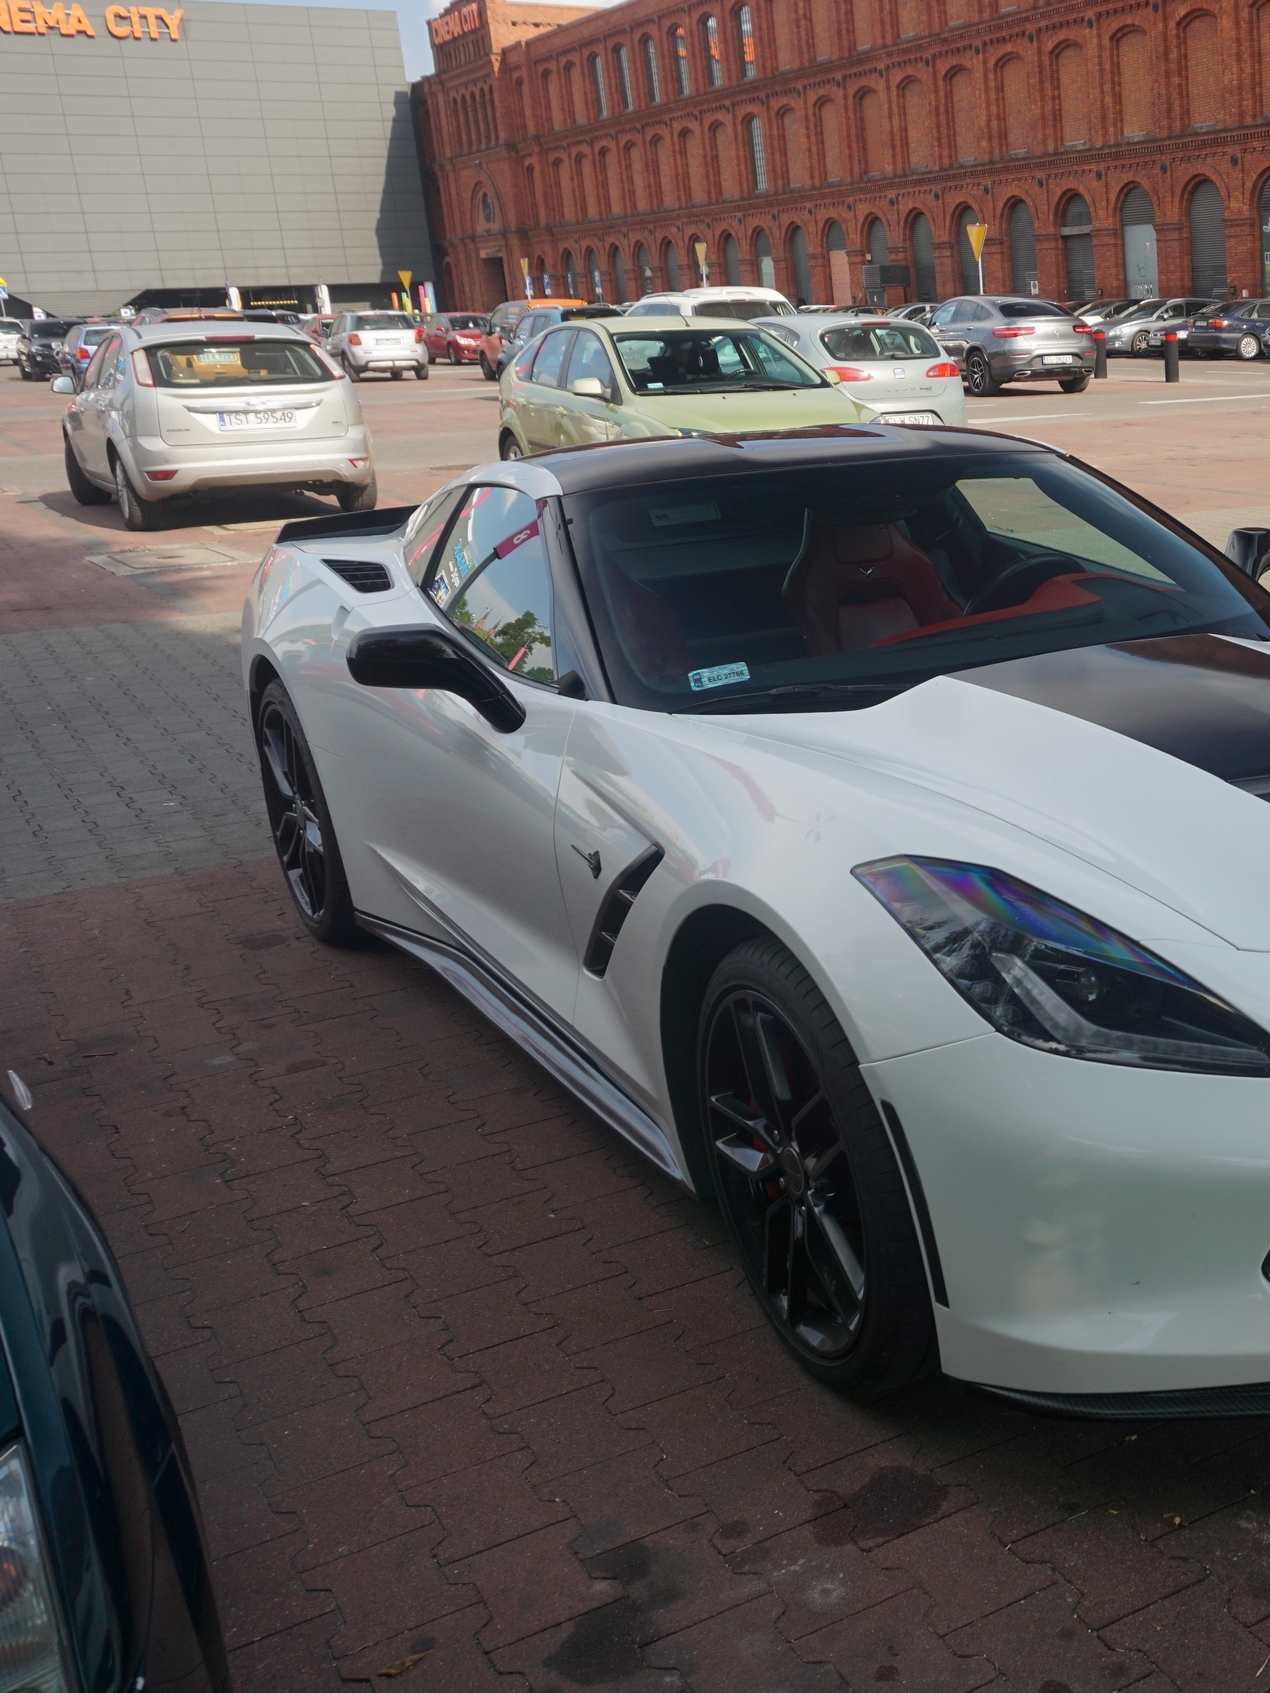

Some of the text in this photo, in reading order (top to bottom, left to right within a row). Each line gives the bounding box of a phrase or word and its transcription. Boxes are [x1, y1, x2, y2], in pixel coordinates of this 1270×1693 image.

[105, 5, 184, 41] CITY
[431, 2, 480, 46] CINEMA CITY
[225, 412, 250, 426] TST
[255, 410, 294, 424] 59549
[707, 670, 745, 683] ELC 27766
